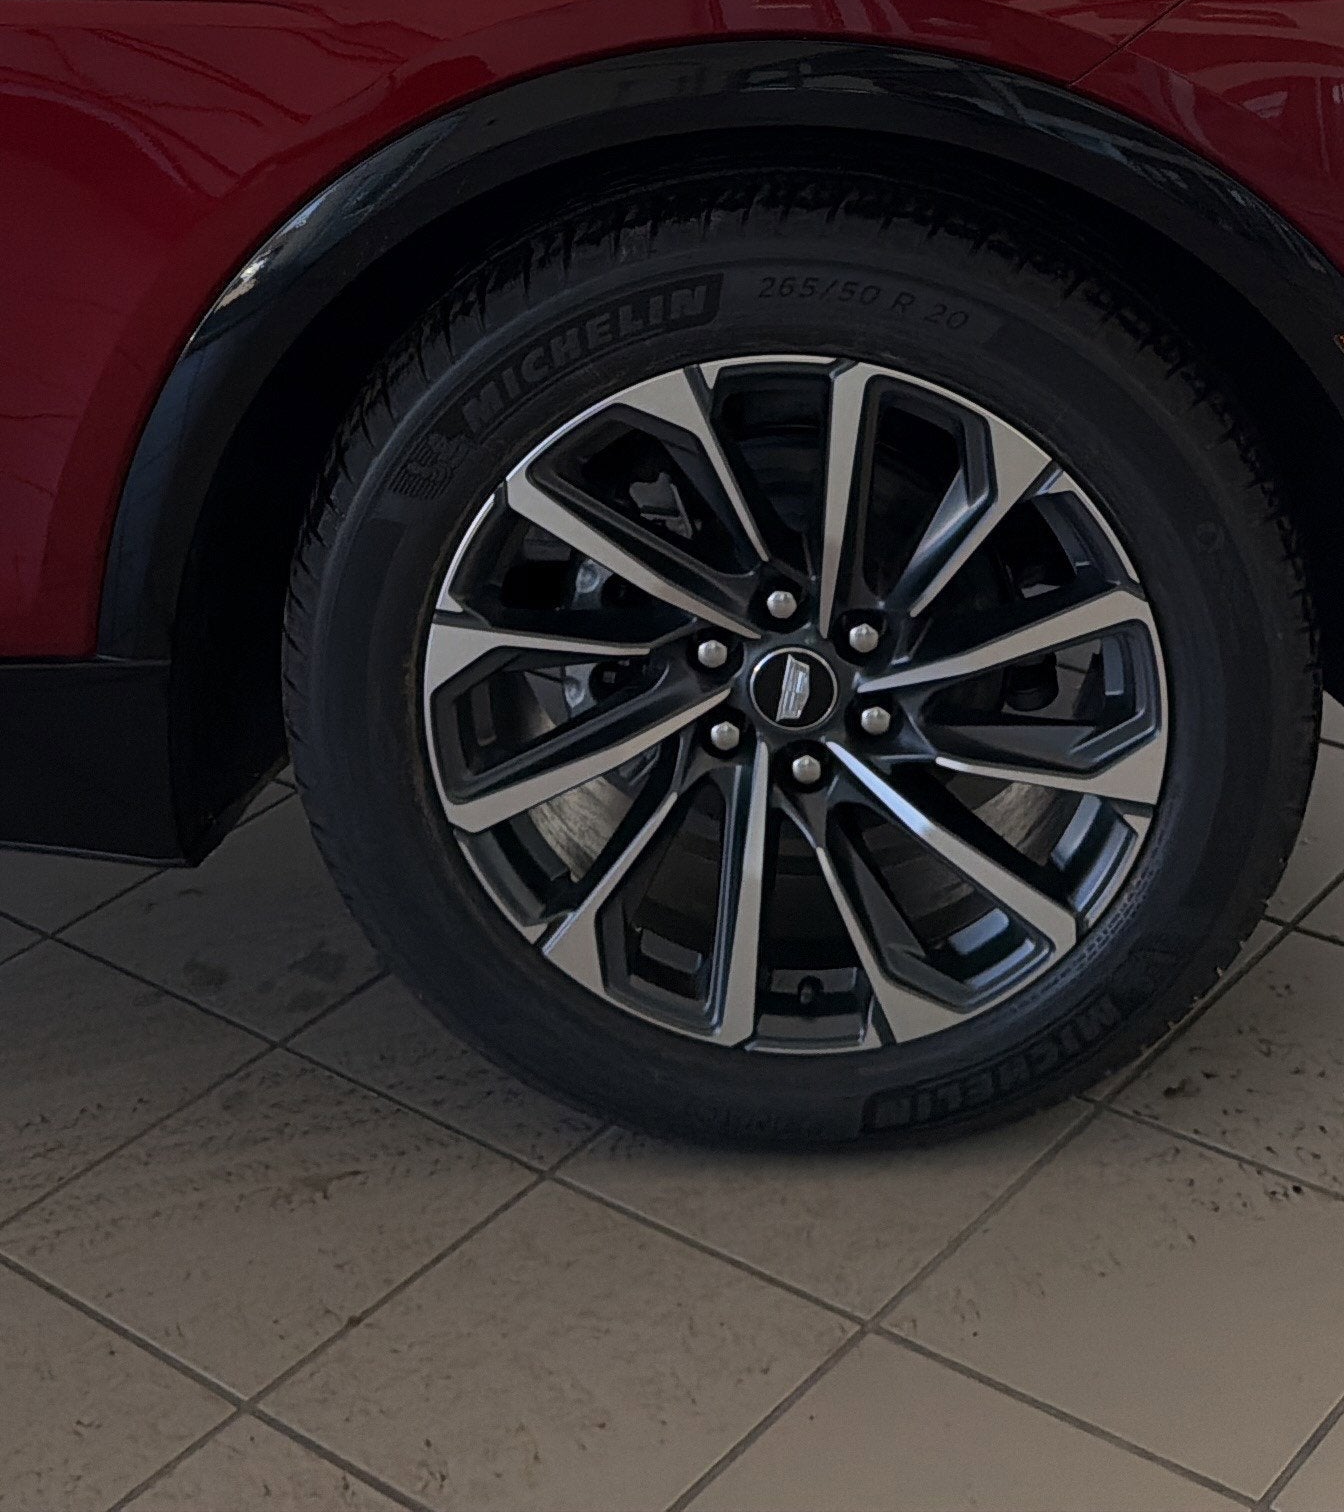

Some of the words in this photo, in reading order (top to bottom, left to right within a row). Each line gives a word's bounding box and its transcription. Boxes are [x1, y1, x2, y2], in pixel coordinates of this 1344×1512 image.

[758, 276, 882, 306] 265/50
[891, 291, 916, 315] R
[923, 302, 970, 330] 20
[462, 284, 711, 434] MICHELIN
